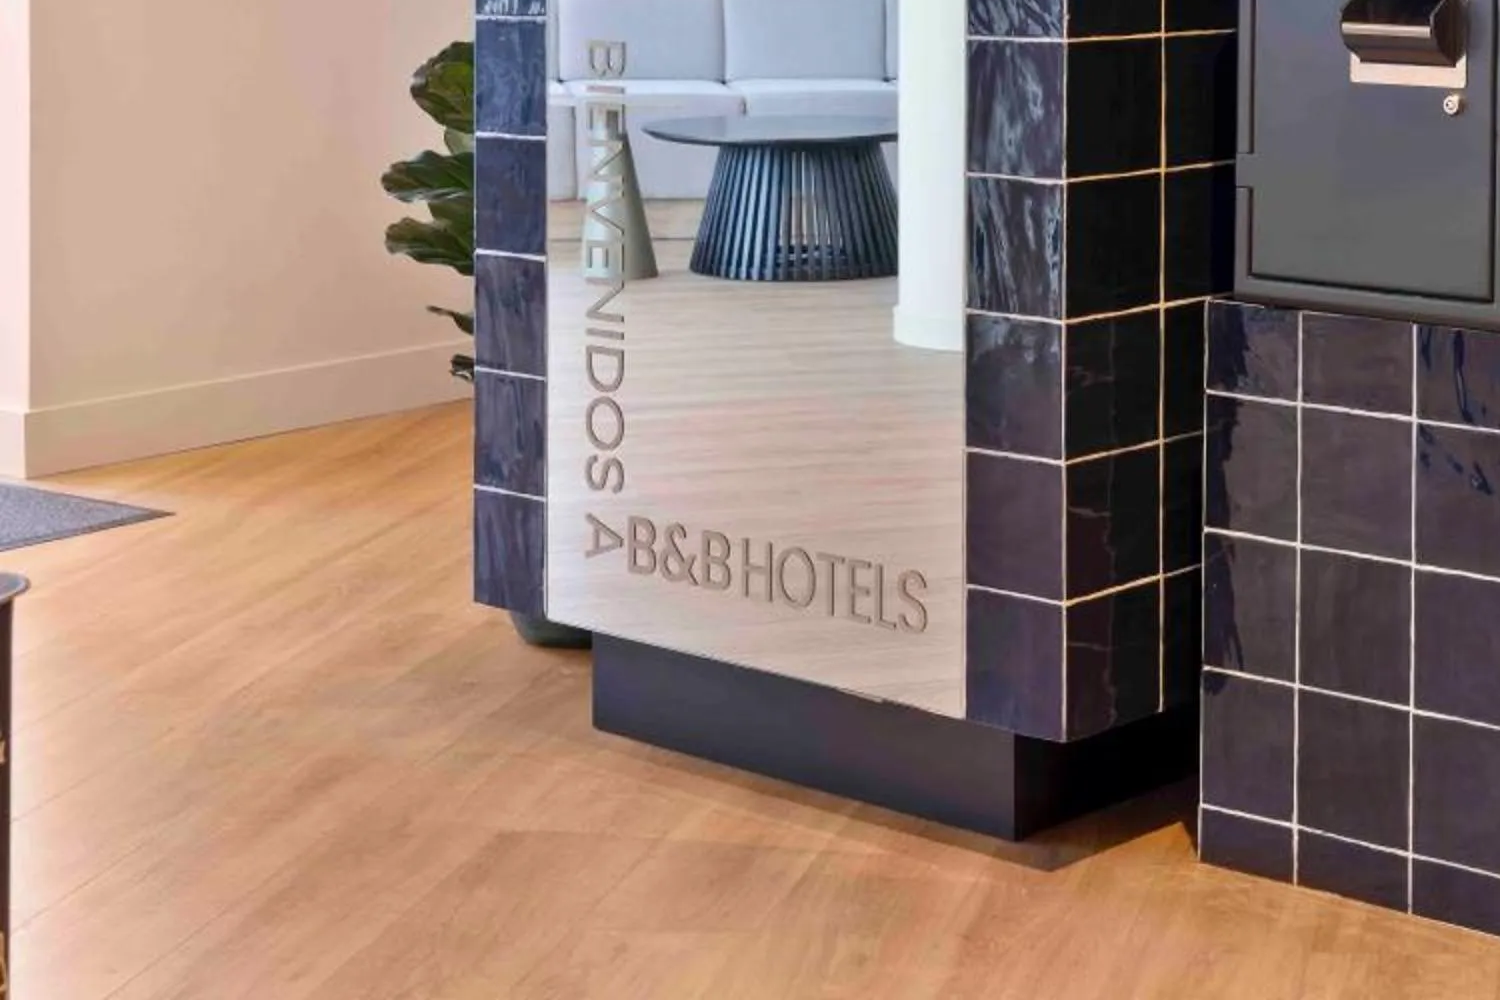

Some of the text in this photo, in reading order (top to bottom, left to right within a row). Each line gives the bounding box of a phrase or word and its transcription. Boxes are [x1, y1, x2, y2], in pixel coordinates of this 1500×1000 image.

[584, 39, 626, 559] BIENVENIDOS A
[627, 505, 928, 634] B&B HOTELS
